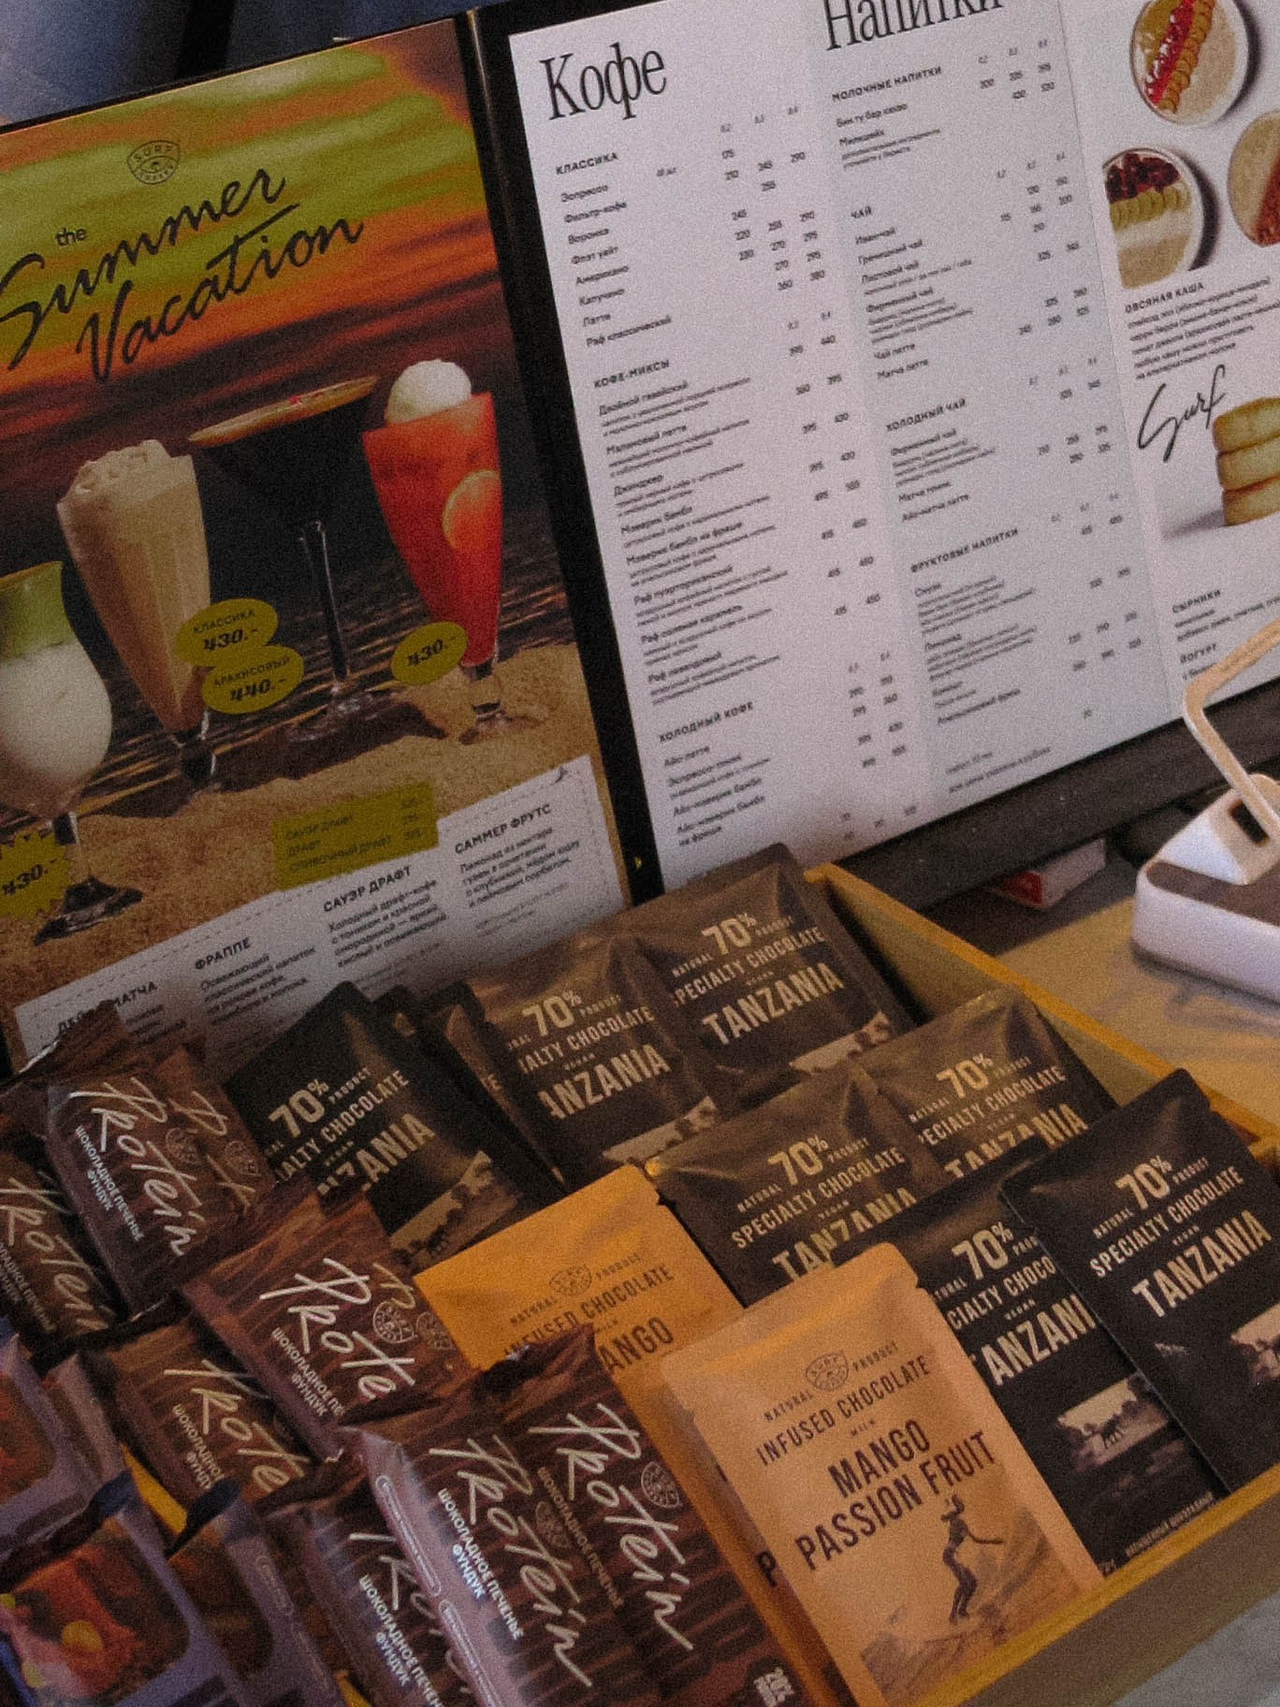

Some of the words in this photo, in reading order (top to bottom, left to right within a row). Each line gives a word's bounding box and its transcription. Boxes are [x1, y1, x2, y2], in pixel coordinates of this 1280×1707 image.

[538, 41, 666, 120] Кофе
[831, 78, 892, 100] МОЛОЧНЫЕ
[893, 65, 941, 84] НАПИТКИ
[555, 151, 618, 174] КЛАССИКА
[55, 226, 87, 245] the
[563, 201, 627, 223] Фильтр-кофе
[850, 205, 872, 218] ЧАЙ
[0, 169, 285, 370] Summer
[77, 203, 363, 382] Vacation
[575, 265, 629, 285] Американо
[1124, 291, 1172, 313] ОВСЯНАЯ
[1174, 281, 1204, 296] КАША
[582, 313, 611, 326] Латте
[593, 359, 669, 388] КОФЕ-МИКСЫ
[885, 405, 944, 431] ХОЛОДНЫЙ
[945, 397, 966, 411] ЧАЙ
[1136, 363, 1226, 462] Surf
[910, 544, 969, 573] ФРУКТОВЫЕ
[971, 527, 1018, 549] НАПИТКИ
[1171, 589, 1221, 613] СЫРНИКИ
[658, 711, 721, 743] ХОЛОДНЫЙ
[723, 701, 753, 718] КОФЕ
[454, 822, 507, 854] САММЕР
[509, 803, 551, 828] ФРУТС
[322, 885, 365, 912] САУЭР
[368, 865, 410, 894] ДРАФТ
[194, 936, 250, 970] ФРАППЕ
[701, 913, 757, 955] 70%
[746, 927, 825, 968] CHOCOLATE
[522, 990, 582, 1037] 70%
[567, 1006, 655, 1050] CHOCOLATE
[702, 962, 844, 1044] TANZANIA
[538, 1044, 671, 1119] ANZANIA
[936, 1053, 993, 1098] 70%
[268, 1079, 329, 1138] 70%
[321, 1070, 409, 1142] CHOCOLATE
[918, 1103, 985, 1145] ECIALTY
[985, 1065, 1067, 1111] CHOCOLATE
[75, 1125, 121, 1199] ШОКОЛАДНОЕ
[767, 1134, 829, 1185] 70%
[87, 1170, 114, 1212] ФУНДУК
[731, 1190, 817, 1248] SPECIALTY
[818, 1147, 905, 1198] CHOCOLATE
[1093, 1208, 1134, 1238] NATURAL
[1115, 1155, 1172, 1210] 70%
[1090, 1214, 1169, 1277] SPECIALTY
[1168, 1166, 1244, 1224] CHOCOLATE
[952, 1222, 1014, 1280] 70%
[1132, 1210, 1272, 1318] TANZANIA
[581, 1265, 674, 1319] CHOCOLATE
[947, 1285, 1002, 1330] CIALTY
[1003, 1256, 1057, 1296] CHOCO
[271, 1327, 331, 1403] ШОКОЛАДНОЕ
[599, 1317, 673, 1372] ANGO
[980, 1294, 1096, 1386] ANZANI
[291, 1373, 328, 1417] ФУНДУК
[764, 1389, 814, 1422] NATURAL
[853, 1341, 899, 1373] PRODUCT
[756, 1408, 835, 1466] INFUSED
[837, 1354, 931, 1419] CHOCOLATE
[828, 1419, 931, 1498] MANGO
[796, 1475, 923, 1570] PASSION
[919, 1431, 995, 1494] FRUIT
[438, 1487, 498, 1584] ШОКОЛАДНОЕ
[486, 1576, 525, 1641] ПЕЧЕНЬЕ
[452, 1544, 487, 1600] ФУНДУК
[359, 1574, 419, 1668] ШОКОЛАДНОЕ
[376, 1632, 410, 1687] ФУНДУК
